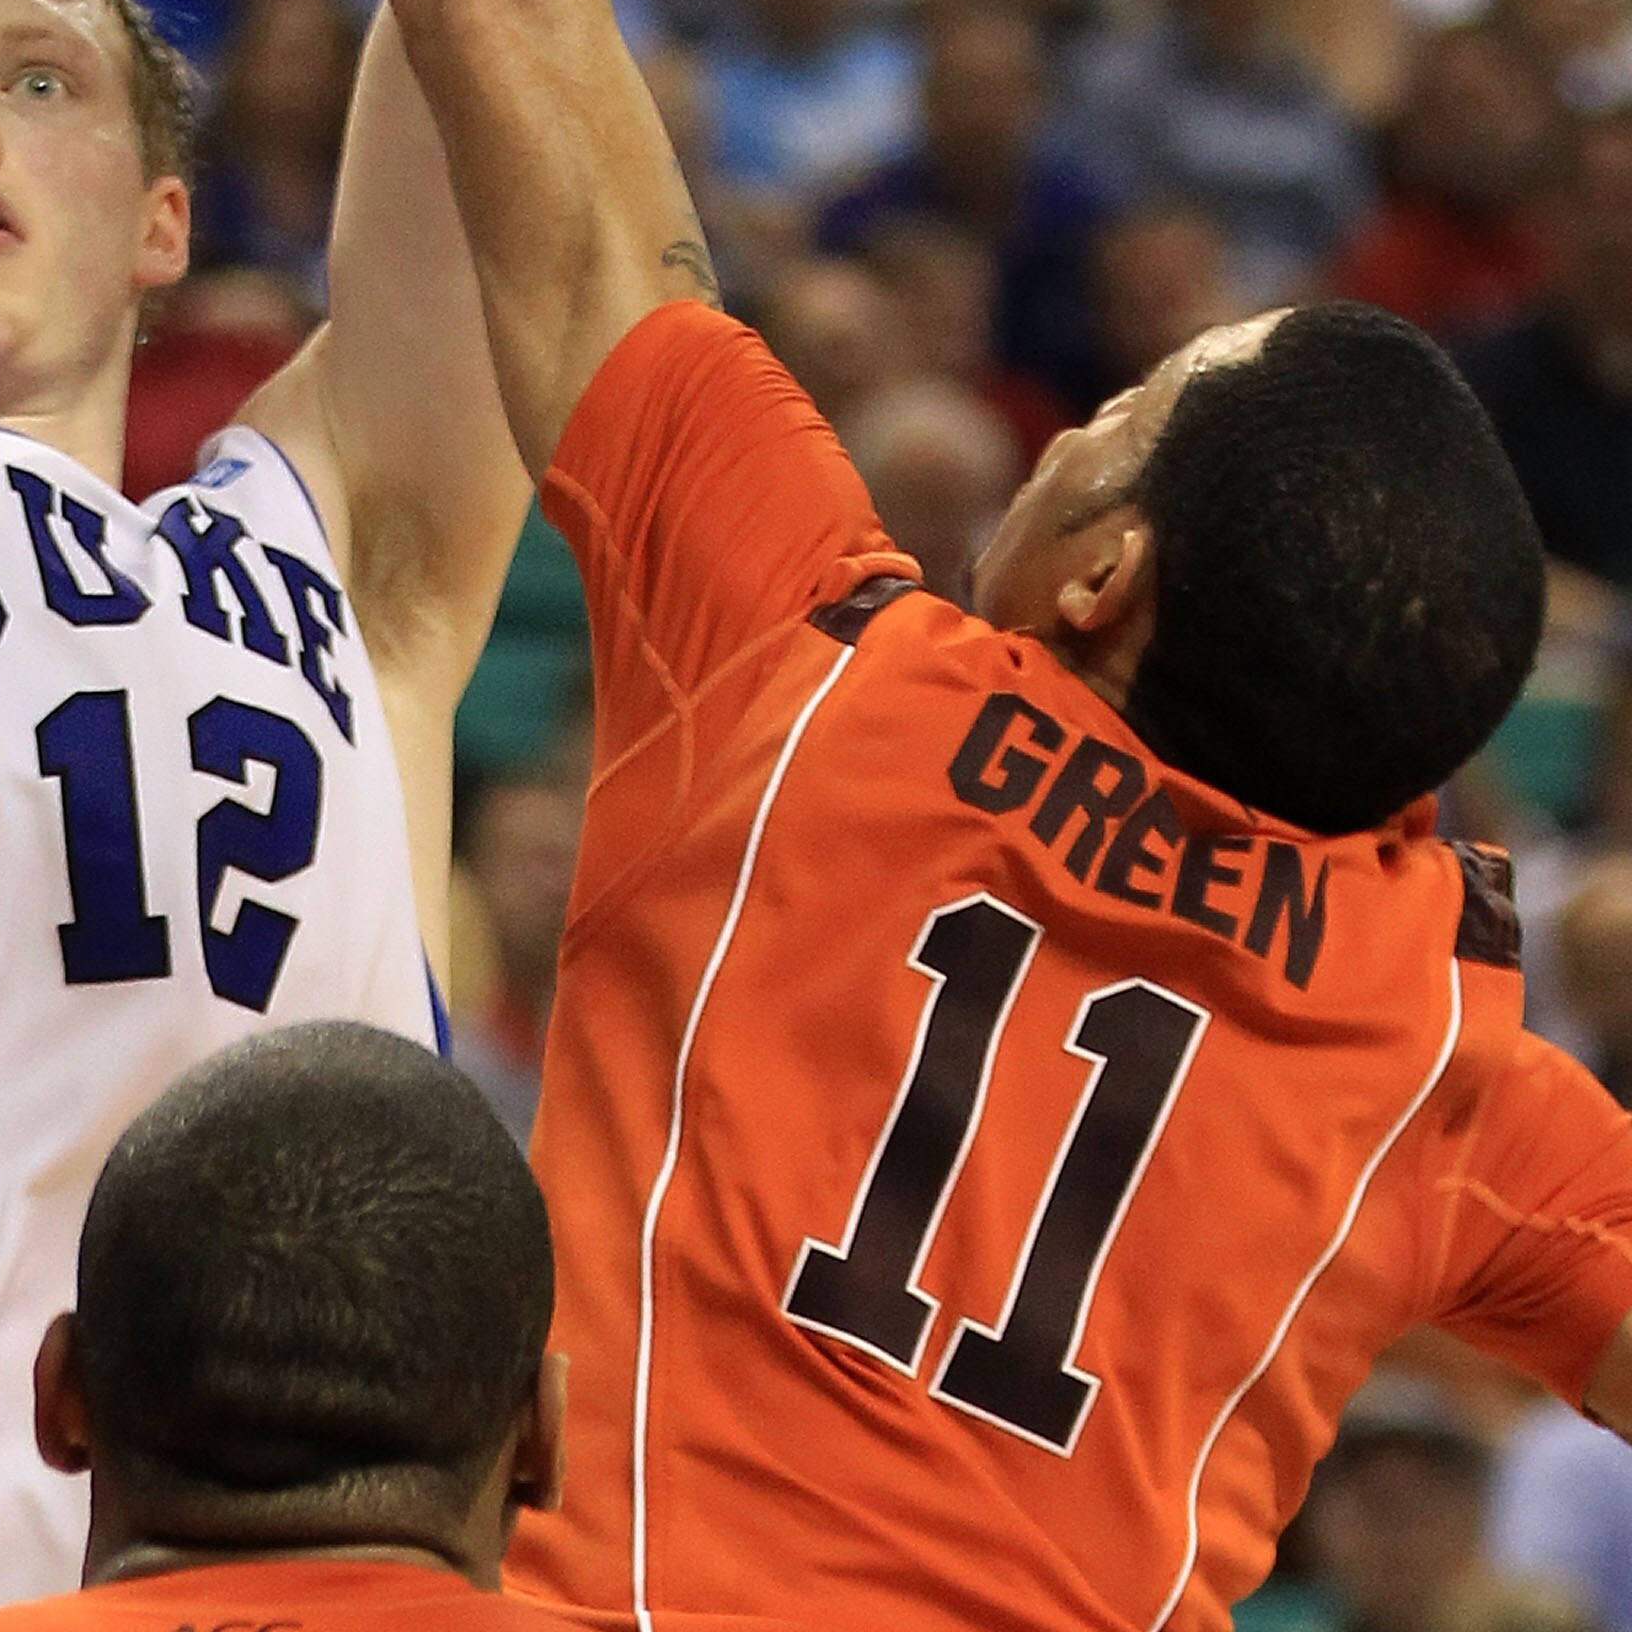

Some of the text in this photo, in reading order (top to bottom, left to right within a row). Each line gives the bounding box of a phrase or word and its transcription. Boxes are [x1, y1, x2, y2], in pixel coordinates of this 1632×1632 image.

[35, 689, 322, 1014] 12
[947, 690, 1332, 991] GREEN
[781, 890, 1212, 1459] 11
